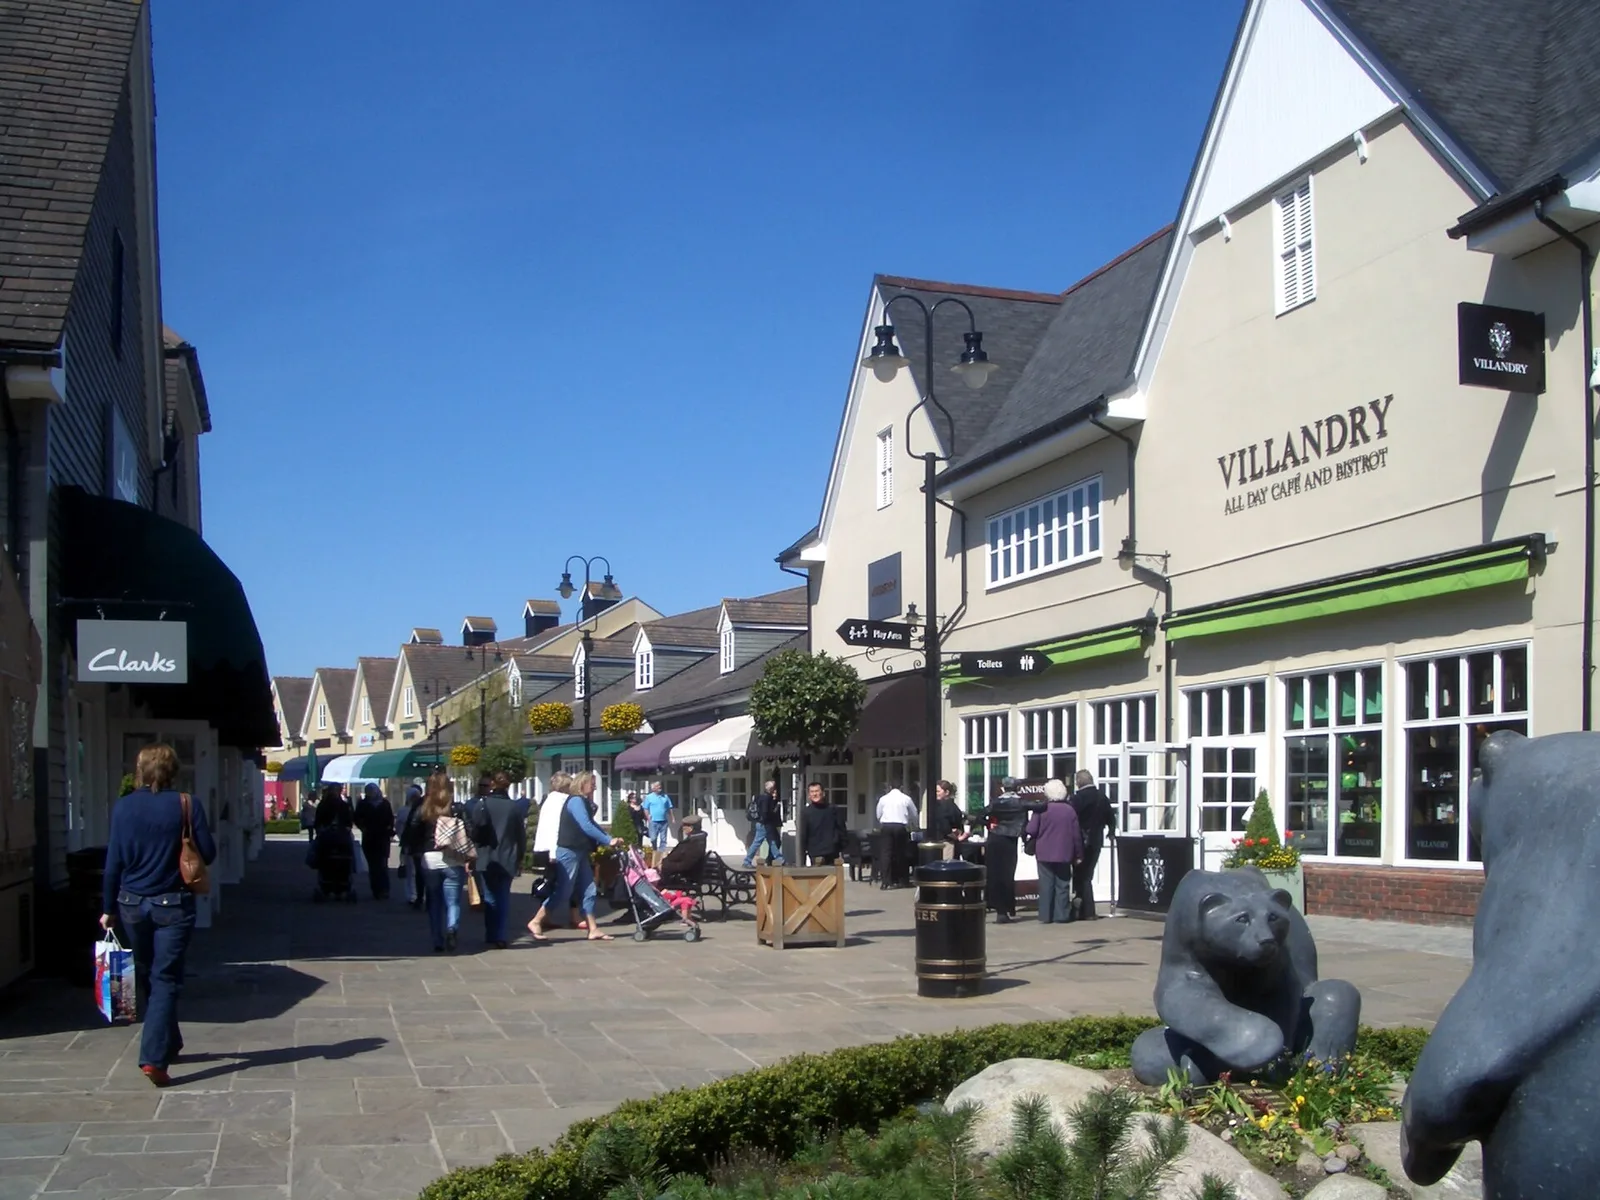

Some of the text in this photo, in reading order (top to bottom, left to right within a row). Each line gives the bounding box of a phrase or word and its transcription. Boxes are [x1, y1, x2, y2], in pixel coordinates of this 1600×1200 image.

[1473, 357, 1528, 375] VILLANDRY
[1217, 393, 1394, 490] VILLANDRY
[1224, 446, 1389, 516] ALL DAY CAFÉ AND BISTROT
[873, 629, 903, 640] Play Area
[88, 647, 177, 673] Clarks
[976, 659, 1003, 669] Toilets
